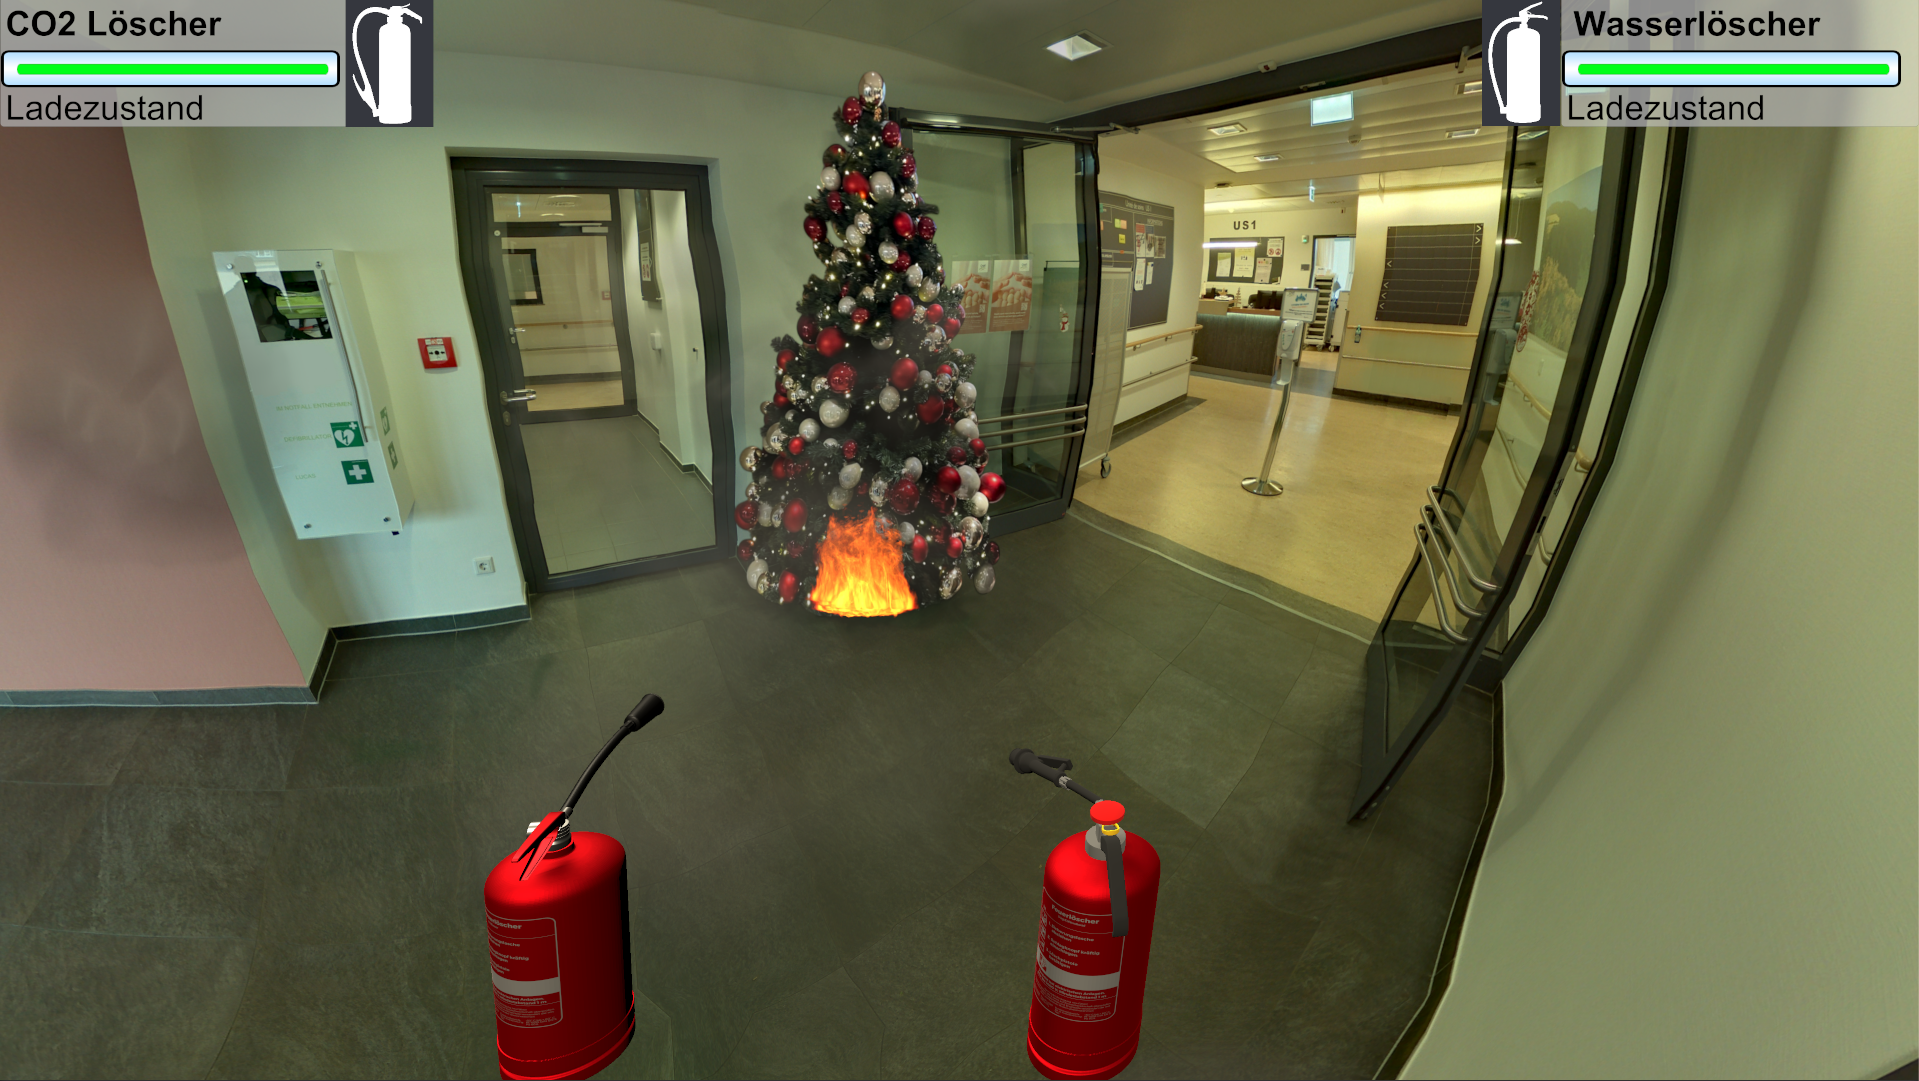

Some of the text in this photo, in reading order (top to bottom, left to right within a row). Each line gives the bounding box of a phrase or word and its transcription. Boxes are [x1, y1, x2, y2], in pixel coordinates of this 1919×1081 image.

[1233, 220, 1256, 231] US1
[284, 403, 312, 411] NOTFALL
[284, 434, 332, 442] DEFIBRILLATOR
